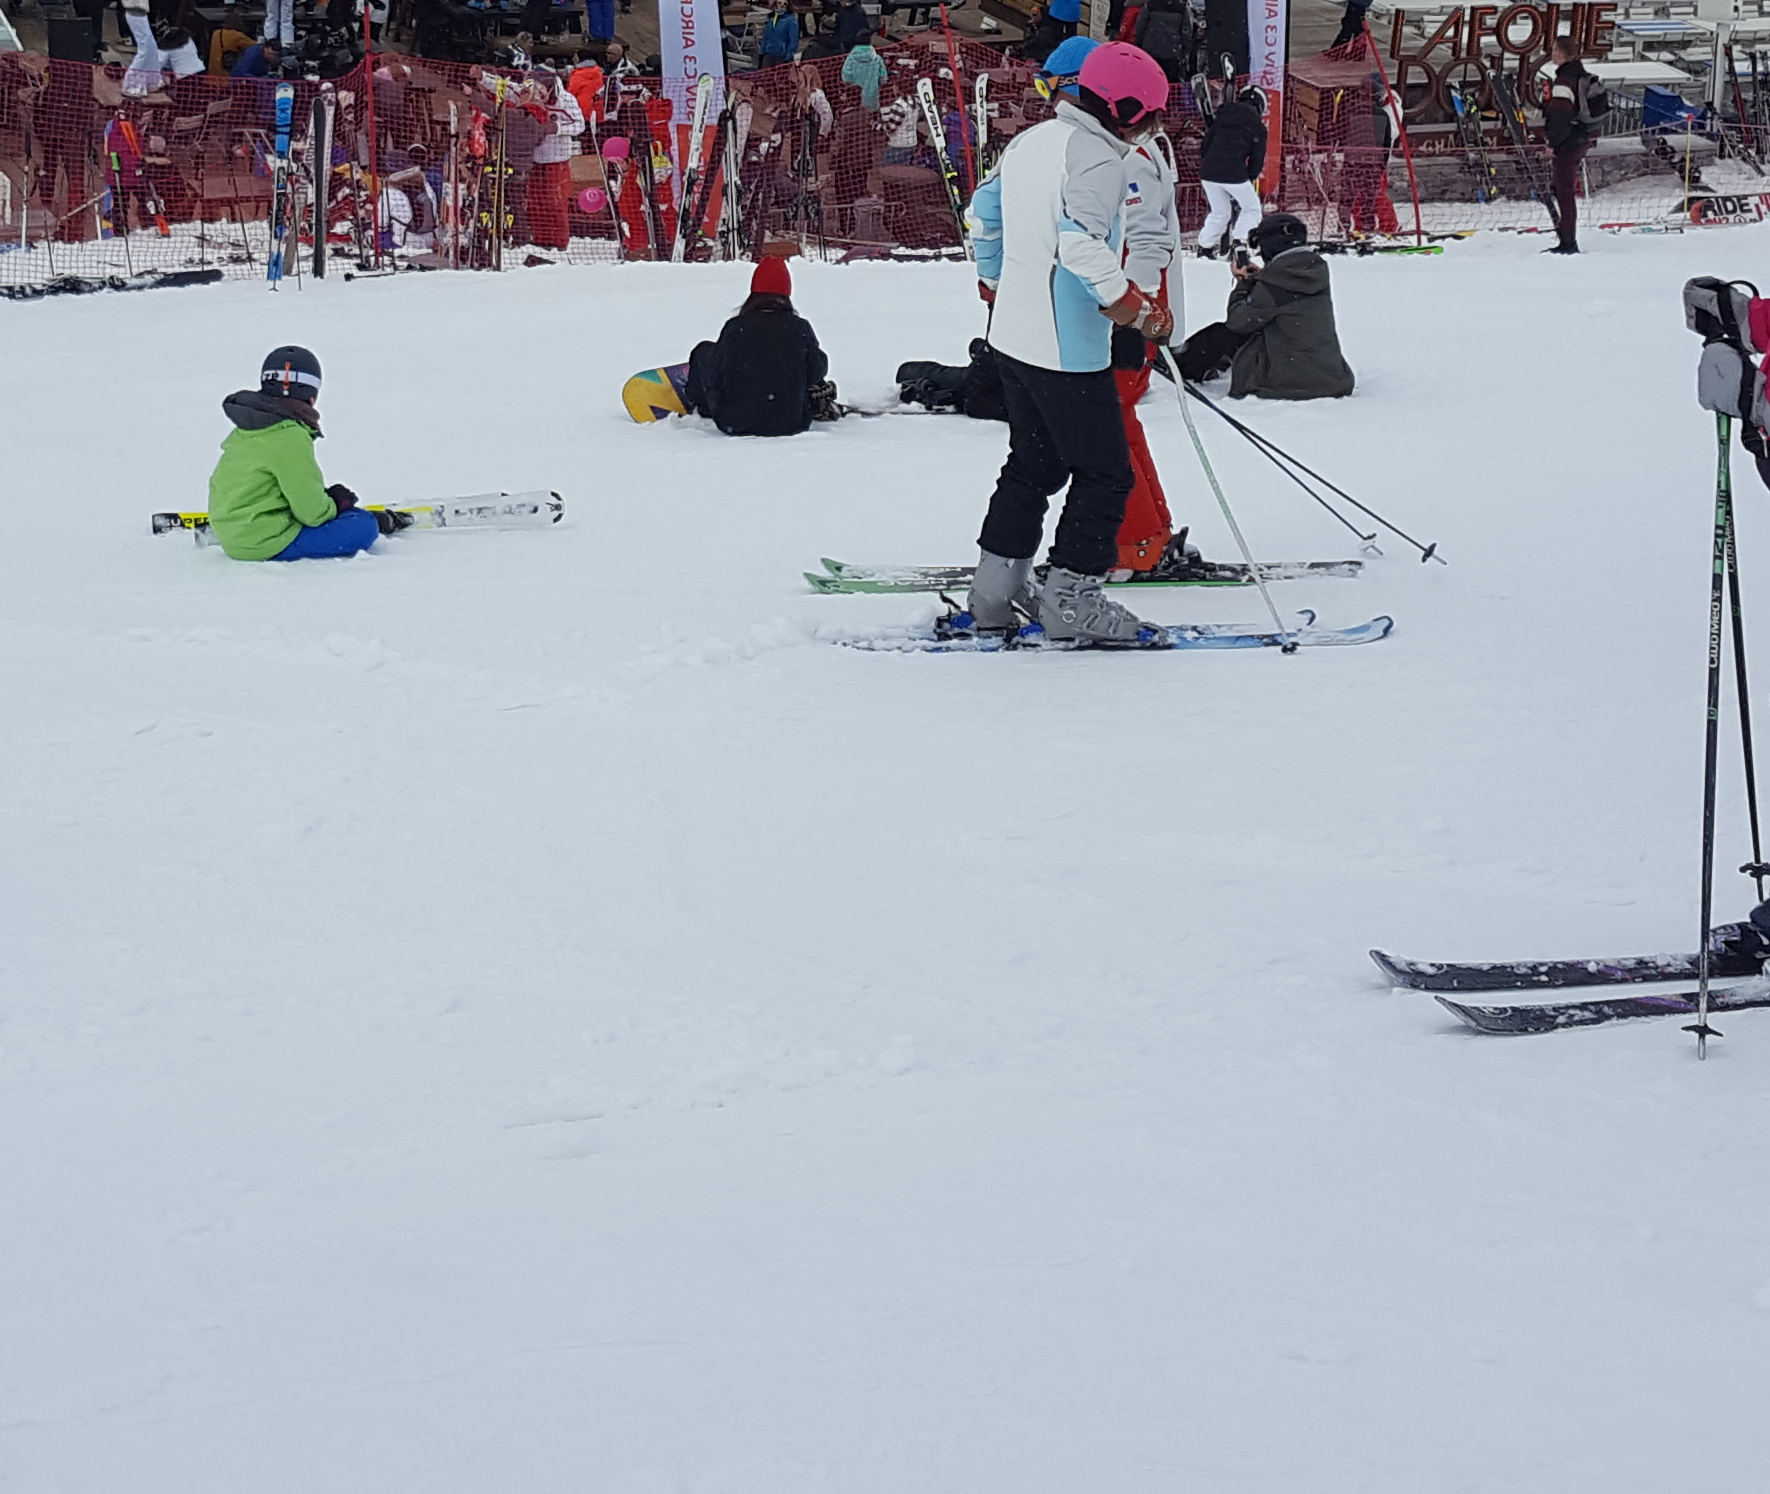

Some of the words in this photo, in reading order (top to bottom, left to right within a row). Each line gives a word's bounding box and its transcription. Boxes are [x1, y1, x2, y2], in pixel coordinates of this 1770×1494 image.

[1389, 5, 1464, 61] LA
[1466, 2, 1618, 63] FOLIE
[1058, 75, 1080, 87] SCO
[923, 92, 942, 138] HEAD
[1702, 196, 1753, 219] RIDE
